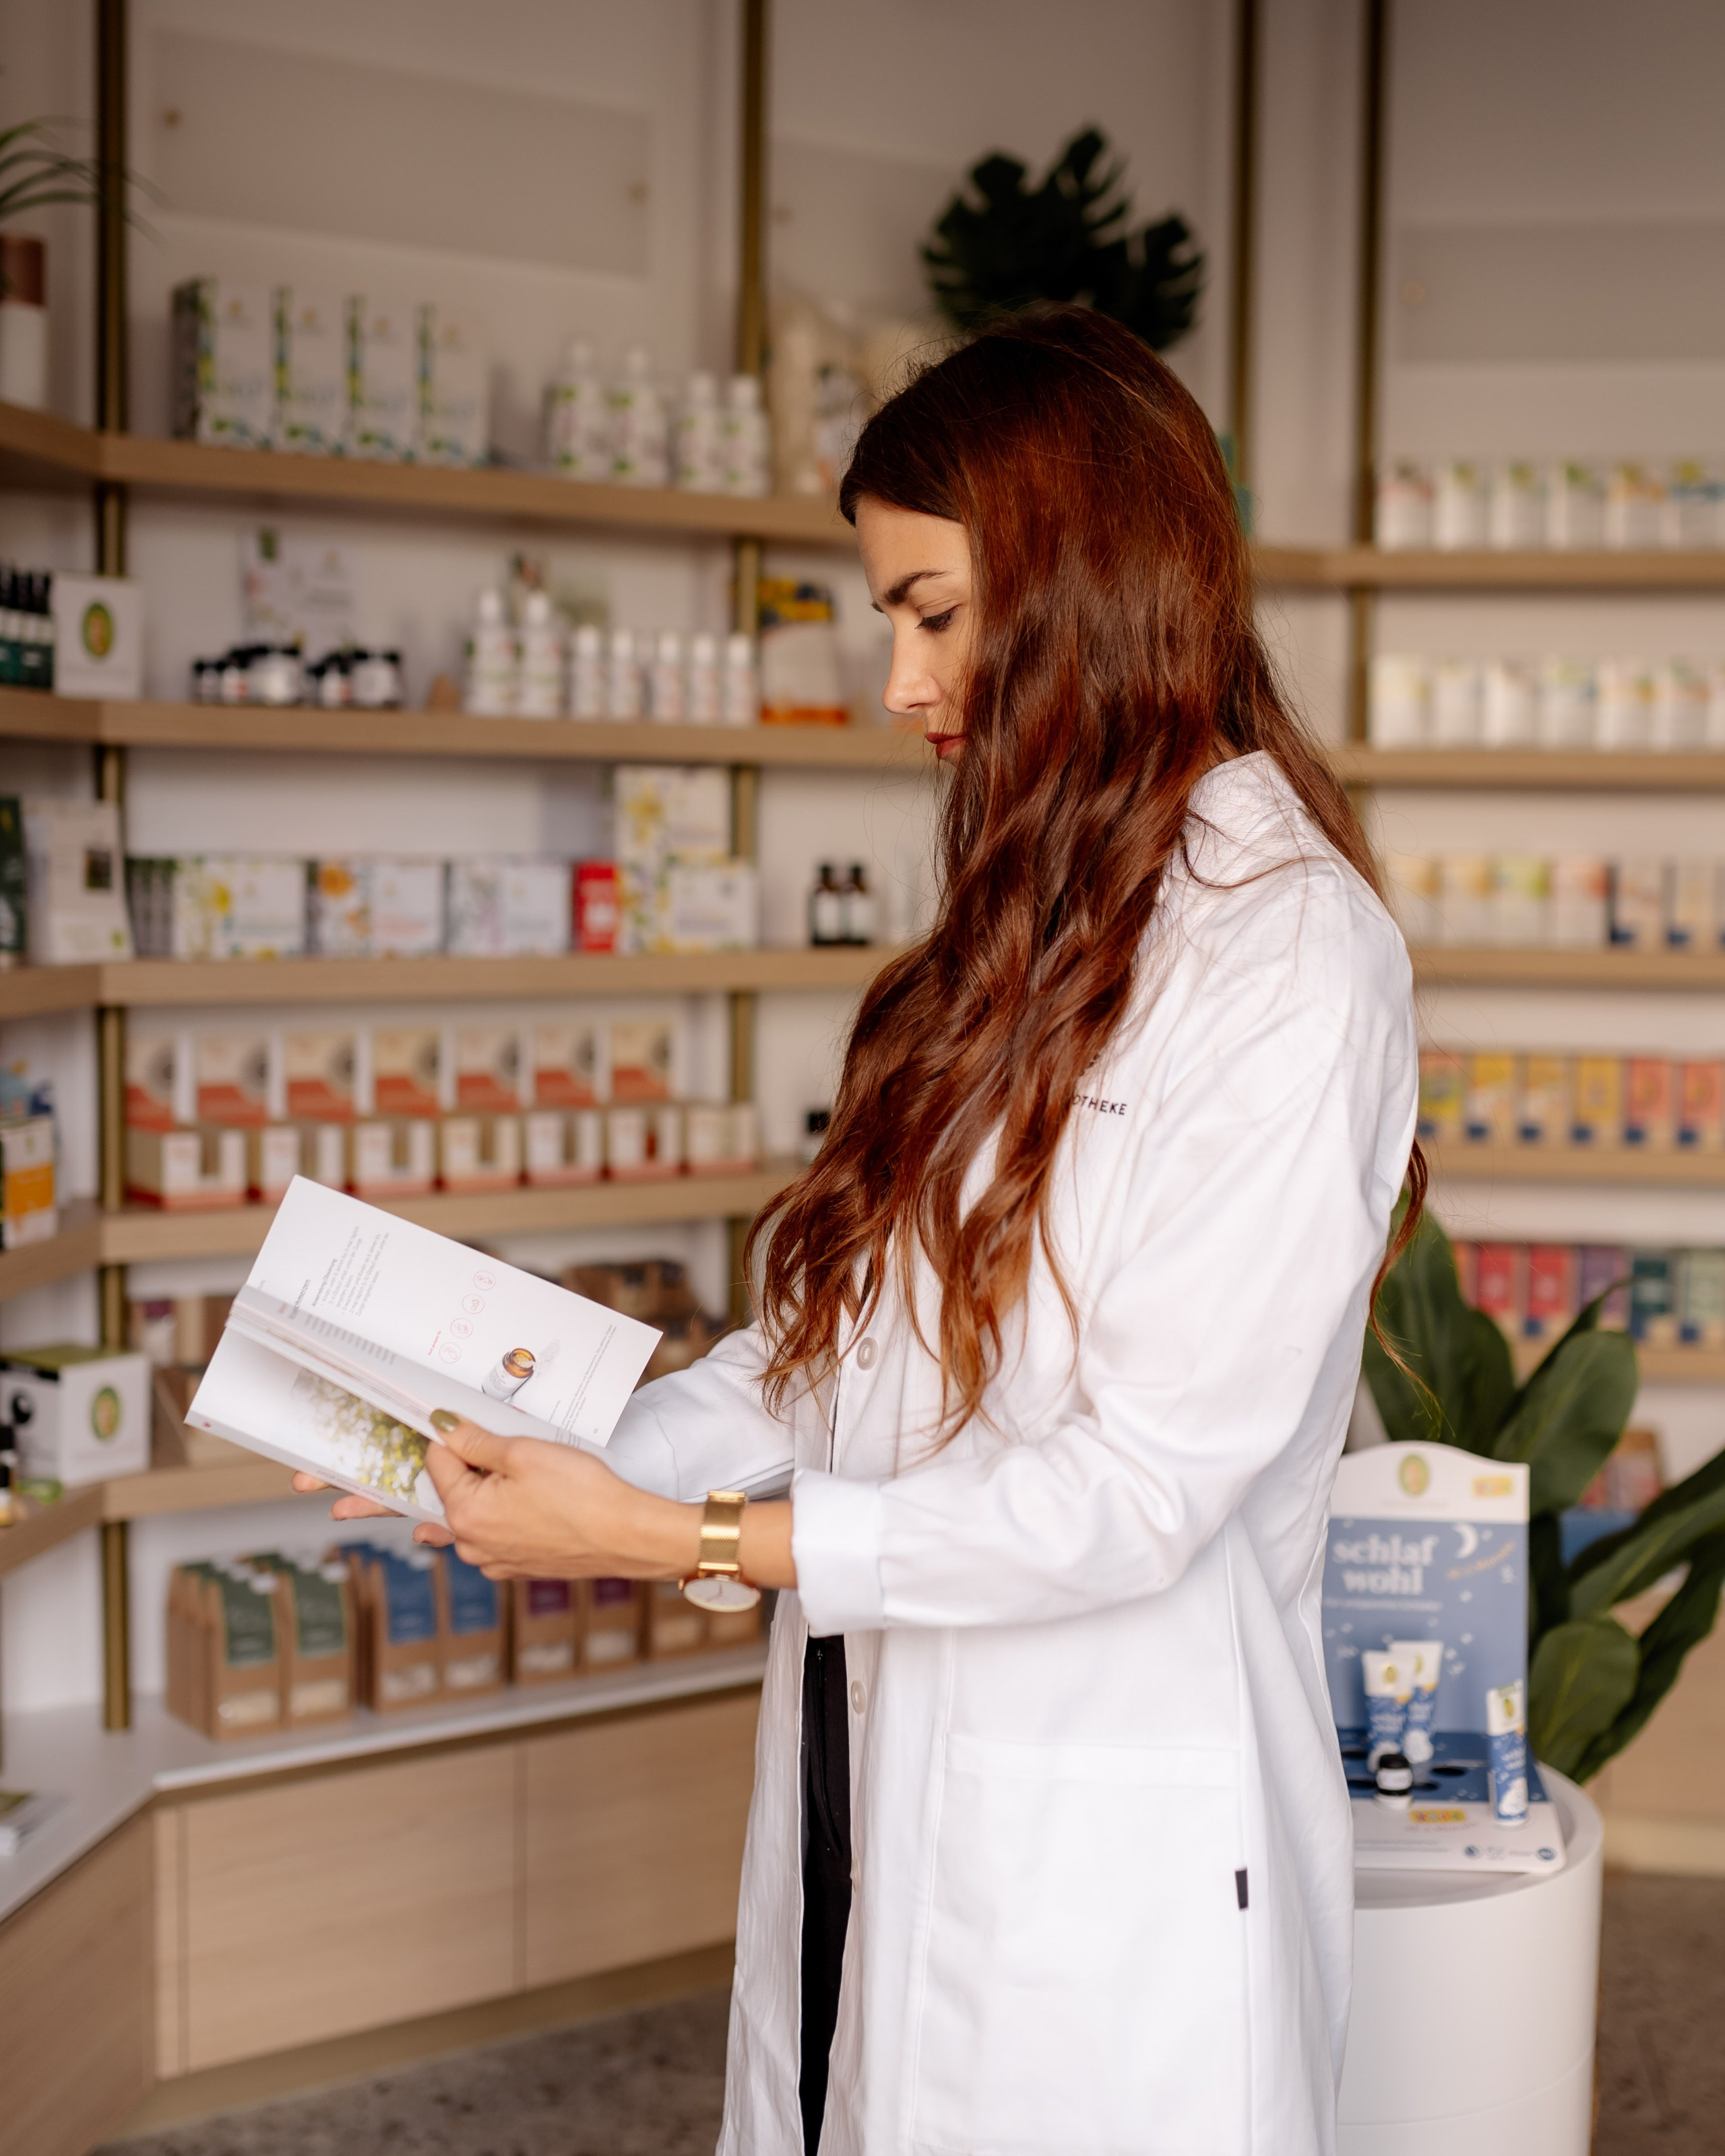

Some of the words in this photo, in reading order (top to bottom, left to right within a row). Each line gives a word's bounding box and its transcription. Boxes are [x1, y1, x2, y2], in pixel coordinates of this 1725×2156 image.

[1073, 1093, 1127, 1116] OTHEKE
[1332, 1533, 1439, 1565] schlaf
[1342, 1566, 1423, 1595] wohl
